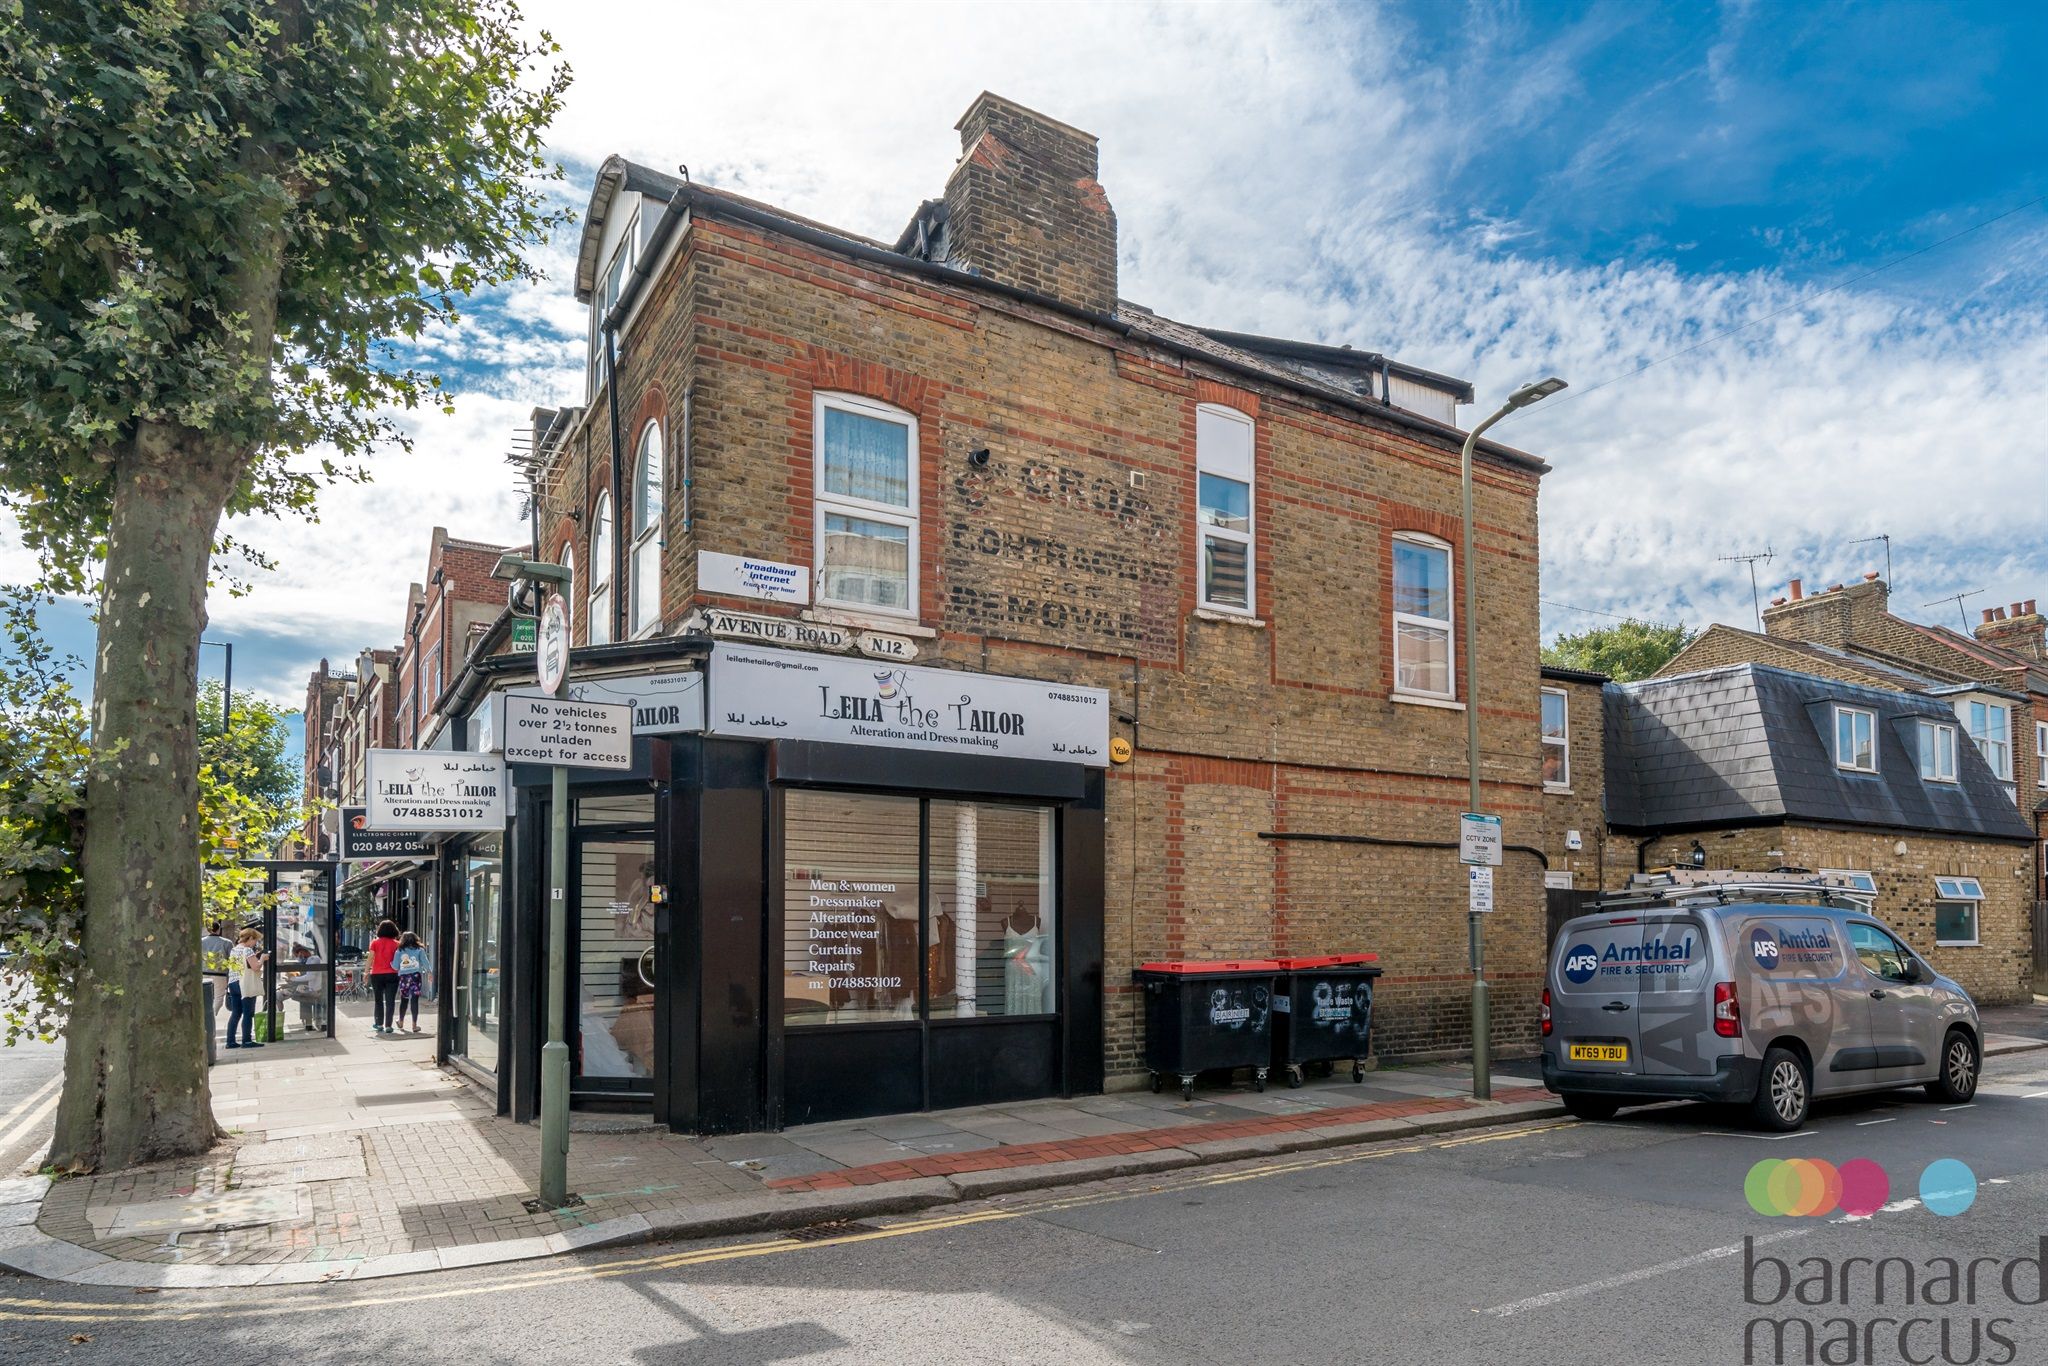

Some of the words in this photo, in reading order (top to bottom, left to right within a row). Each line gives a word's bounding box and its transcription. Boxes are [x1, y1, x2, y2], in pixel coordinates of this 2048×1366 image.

[744, 562, 796, 576] broadband
[750, 572, 790, 584] internet
[768, 584, 780, 592] per
[781, 586, 796, 594] hour
[716, 617, 787, 638] AVENUE
[796, 627, 841, 646] ROAD
[726, 654, 818, 672] leilathetailor@gmail.com
[650, 676, 688, 686] 07488531012
[1048, 692, 1097, 704] 07488531012
[531, 704, 548, 715] No
[554, 706, 607, 720] vehicles
[629, 699, 680, 727] AILOR
[818, 686, 884, 722] LEILA
[897, 696, 939, 728] the
[948, 695, 1024, 736] TAILOR
[519, 720, 547, 728] over
[575, 721, 617, 734] tonnes
[540, 734, 592, 746] unladen
[850, 725, 904, 739] Alteration
[907, 731, 927, 741] and
[930, 732, 958, 744] Dress
[960, 736, 998, 749] making
[508, 747, 552, 759] except
[560, 748, 577, 760] for
[583, 753, 627, 763] access
[1114, 746, 1130, 756] Yale
[378, 780, 413, 796] LEILA
[422, 782, 445, 796] the
[451, 778, 496, 797] TAILOR
[440, 798, 460, 806] Dress
[392, 808, 483, 818] 07488531012
[1466, 834, 1480, 842] CCTV
[352, 842, 373, 852] 020
[376, 842, 402, 851] 8492
[810, 879, 836, 890] Men
[839, 880, 850, 891] &
[852, 882, 896, 892] women
[554, 889, 560, 898] 1
[810, 896, 882, 908] Dressmaker
[810, 912, 876, 923] Alterations
[810, 928, 848, 938] Dance
[850, 930, 880, 938] wear
[1779, 928, 1831, 948] Amthal
[809, 944, 862, 956] Curtains
[1602, 938, 1692, 962] Amthal
[1754, 940, 1778, 957] AFS
[1782, 954, 1796, 962] FIRE
[1804, 952, 1833, 962] SECURITY
[809, 960, 855, 974] Repairs
[1566, 955, 1597, 972] AFS
[1600, 966, 1622, 976] FIRE
[1624, 966, 1632, 975] &
[1636, 964, 1689, 975] SECURITY
[808, 981, 824, 989] m:
[828, 976, 902, 989] 07488531012
[1216, 1009, 1249, 1019] BARNET
[1602, 1048, 1622, 1059] YBU
